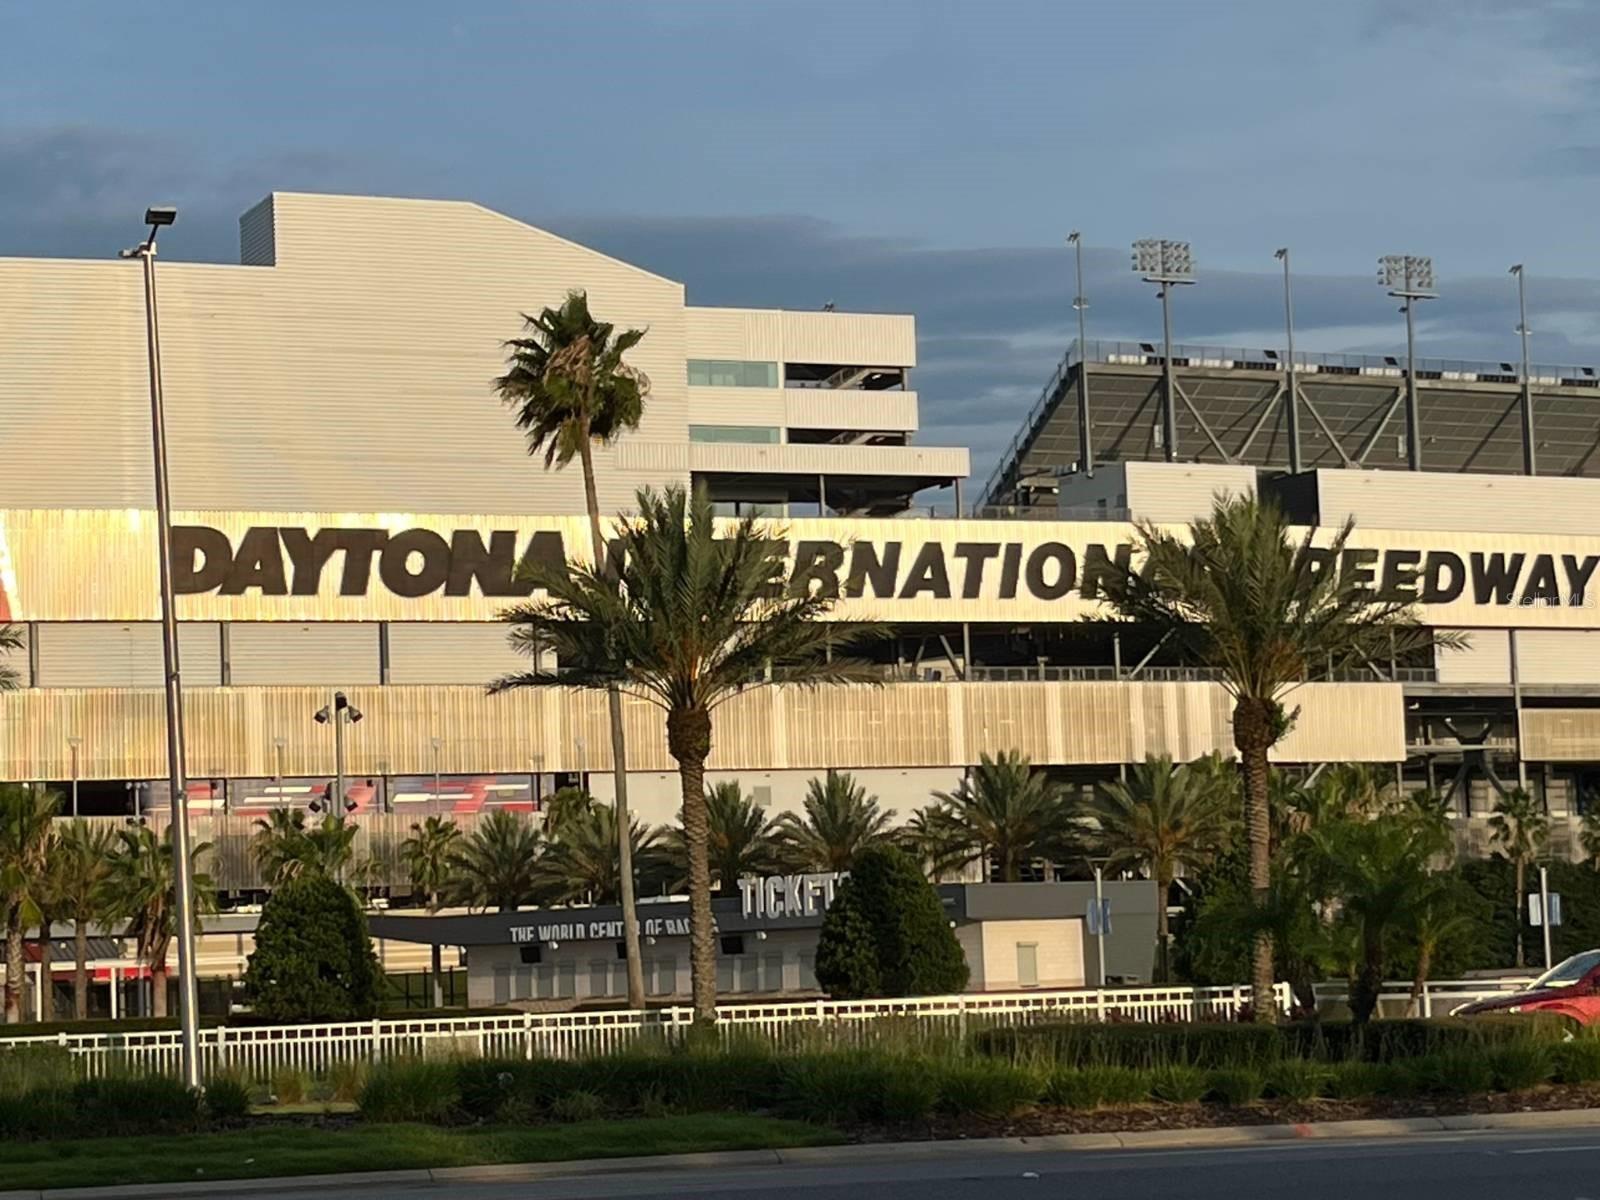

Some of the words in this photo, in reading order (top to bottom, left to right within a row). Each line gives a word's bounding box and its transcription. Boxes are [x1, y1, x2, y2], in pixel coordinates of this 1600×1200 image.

[170, 525, 572, 598] DAYTONA
[1291, 547, 1600, 607] PEEDWAY
[509, 926, 535, 942] THE
[645, 918, 663, 936] OF
